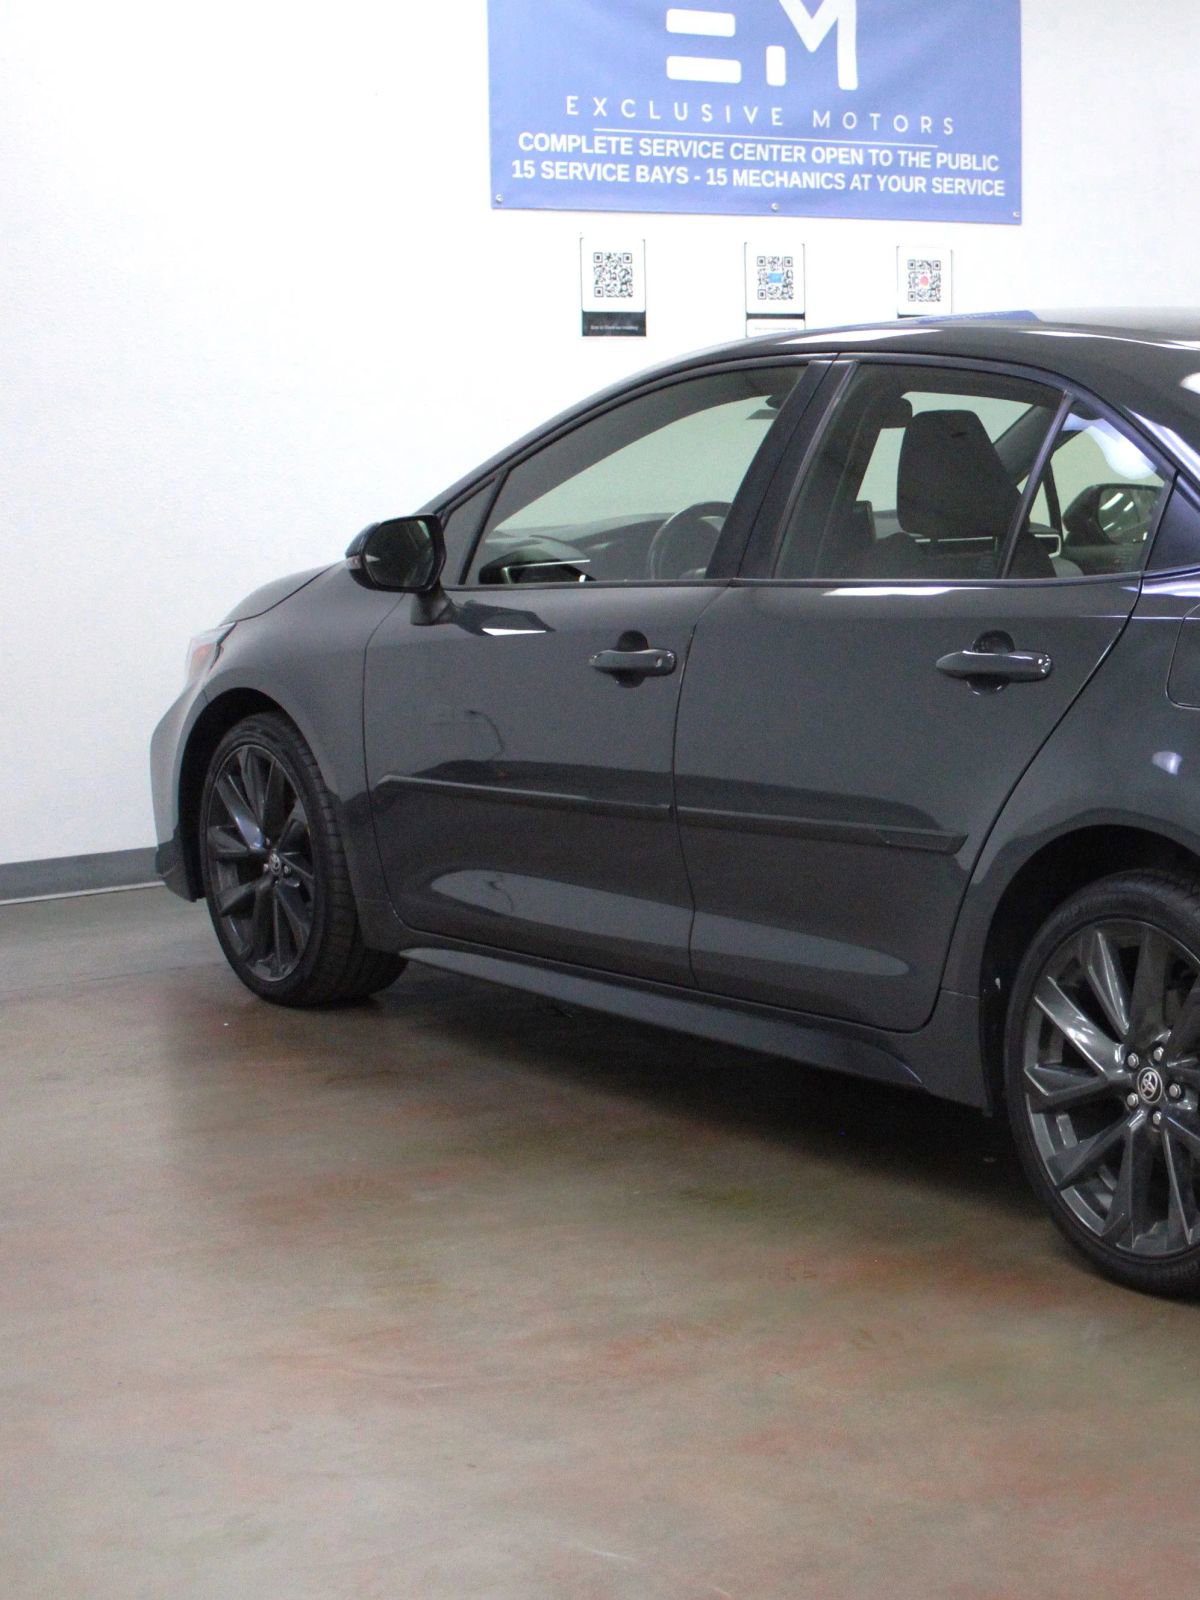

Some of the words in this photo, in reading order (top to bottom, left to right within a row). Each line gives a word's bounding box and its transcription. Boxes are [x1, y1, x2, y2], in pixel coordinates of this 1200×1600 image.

[566, 96, 783, 126] EXCLUSIVE
[813, 110, 954, 135] MOTORS
[518, 132, 633, 156] COMPLETE
[639, 138, 724, 160] SERVICE
[729, 141, 806, 163] CENTER
[811, 146, 863, 166] OPEN
[868, 149, 892, 167] TO
[898, 150, 931, 168] THE
[936, 152, 999, 172] PUBLIC
[511, 160, 535, 179] 15
[541, 161, 630, 182] SERVICE
[635, 165, 689, 185] BAYS
[706, 168, 727, 186] 15
[733, 169, 846, 190] MECHANICS
[850, 173, 872, 191] AT
[876, 174, 926, 193] YOUR
[932, 177, 1005, 197] SERVICE
